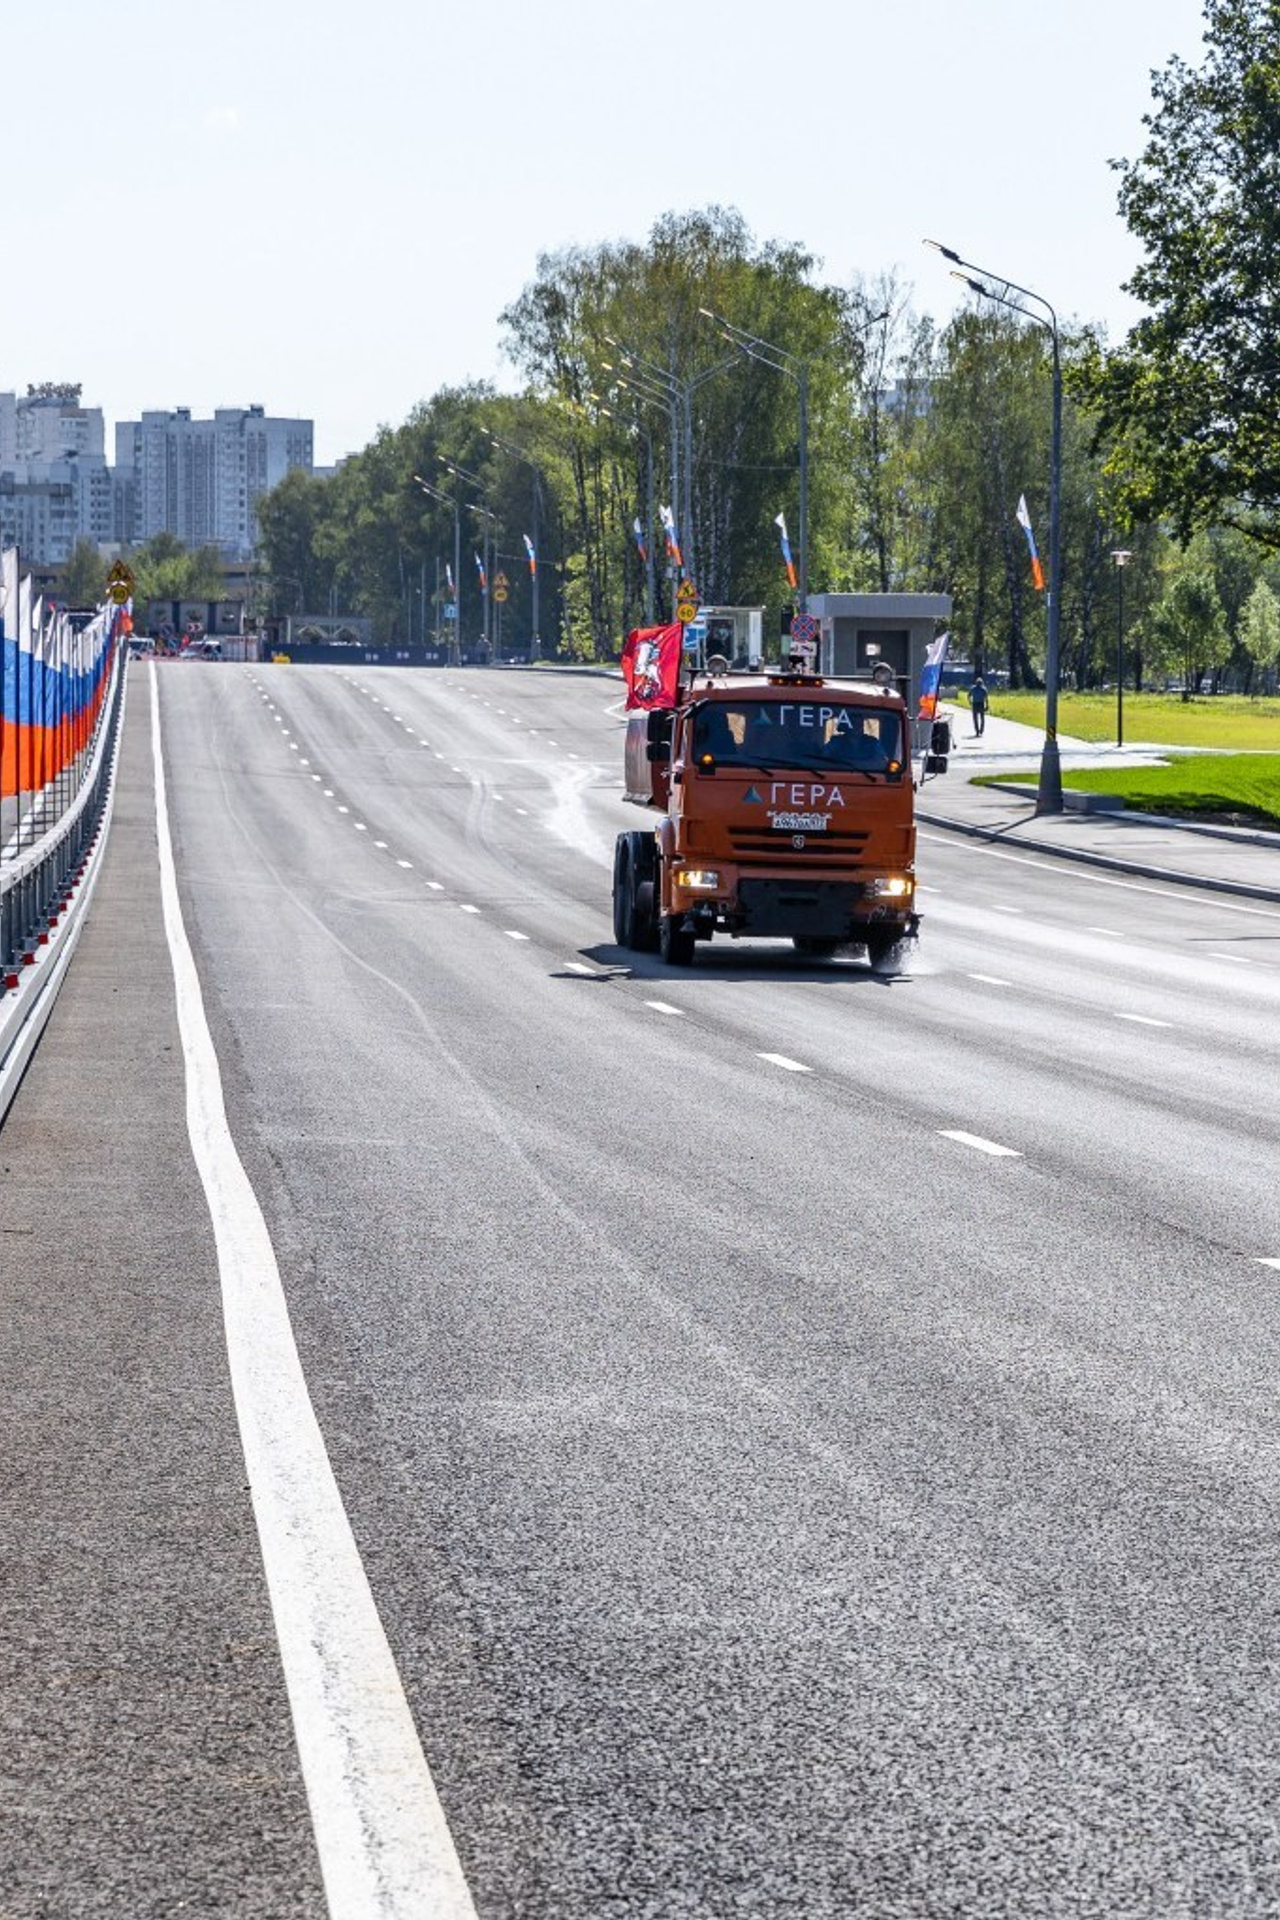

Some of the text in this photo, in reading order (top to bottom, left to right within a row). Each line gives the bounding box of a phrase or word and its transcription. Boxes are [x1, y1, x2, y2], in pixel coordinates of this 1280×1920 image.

[680, 608, 693, 618] 60
[780, 705, 853, 728] ГЕРА
[771, 783, 845, 807] ГЕРА
